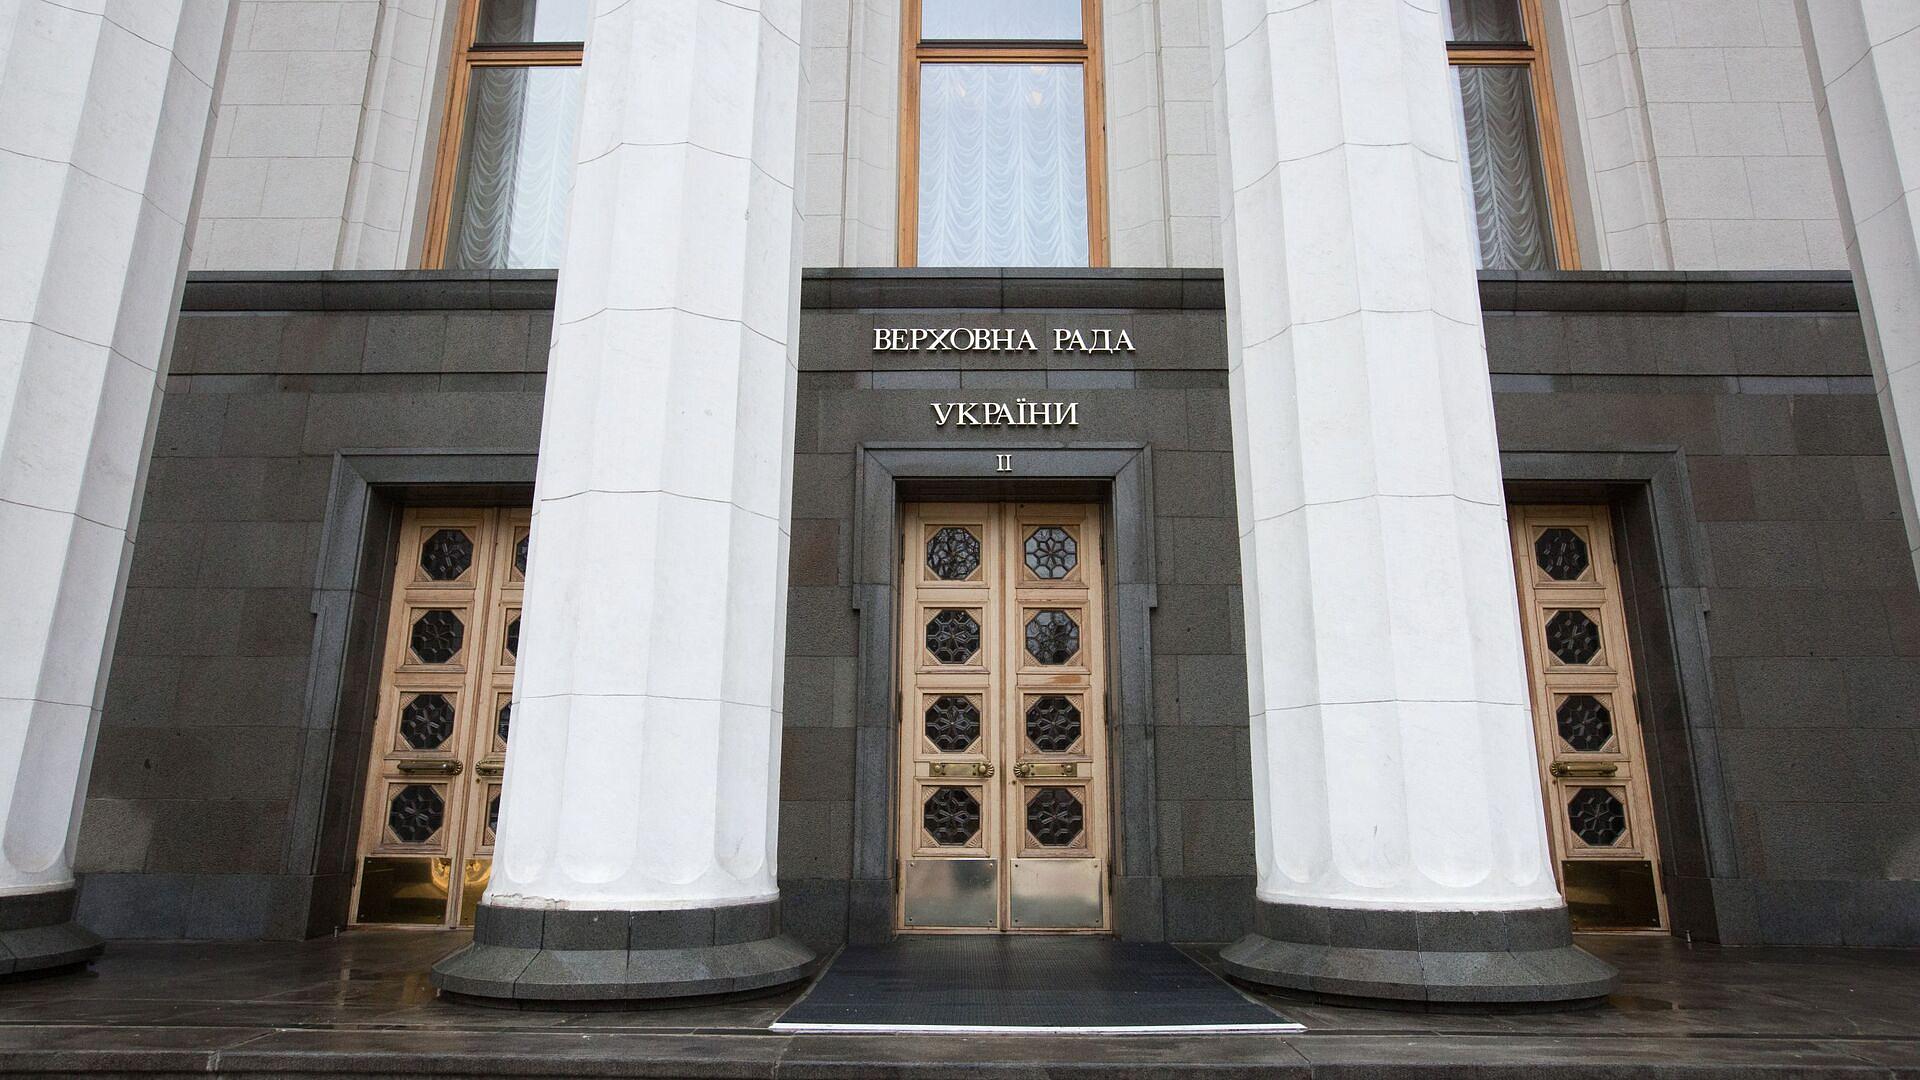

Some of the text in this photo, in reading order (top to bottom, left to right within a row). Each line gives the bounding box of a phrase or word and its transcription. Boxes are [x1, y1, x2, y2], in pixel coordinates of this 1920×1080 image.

[873, 327, 1136, 354] ВЕРХОВНА РАДА
[930, 398, 1079, 426] УКРАЇНИ
[996, 454, 1012, 471] II
